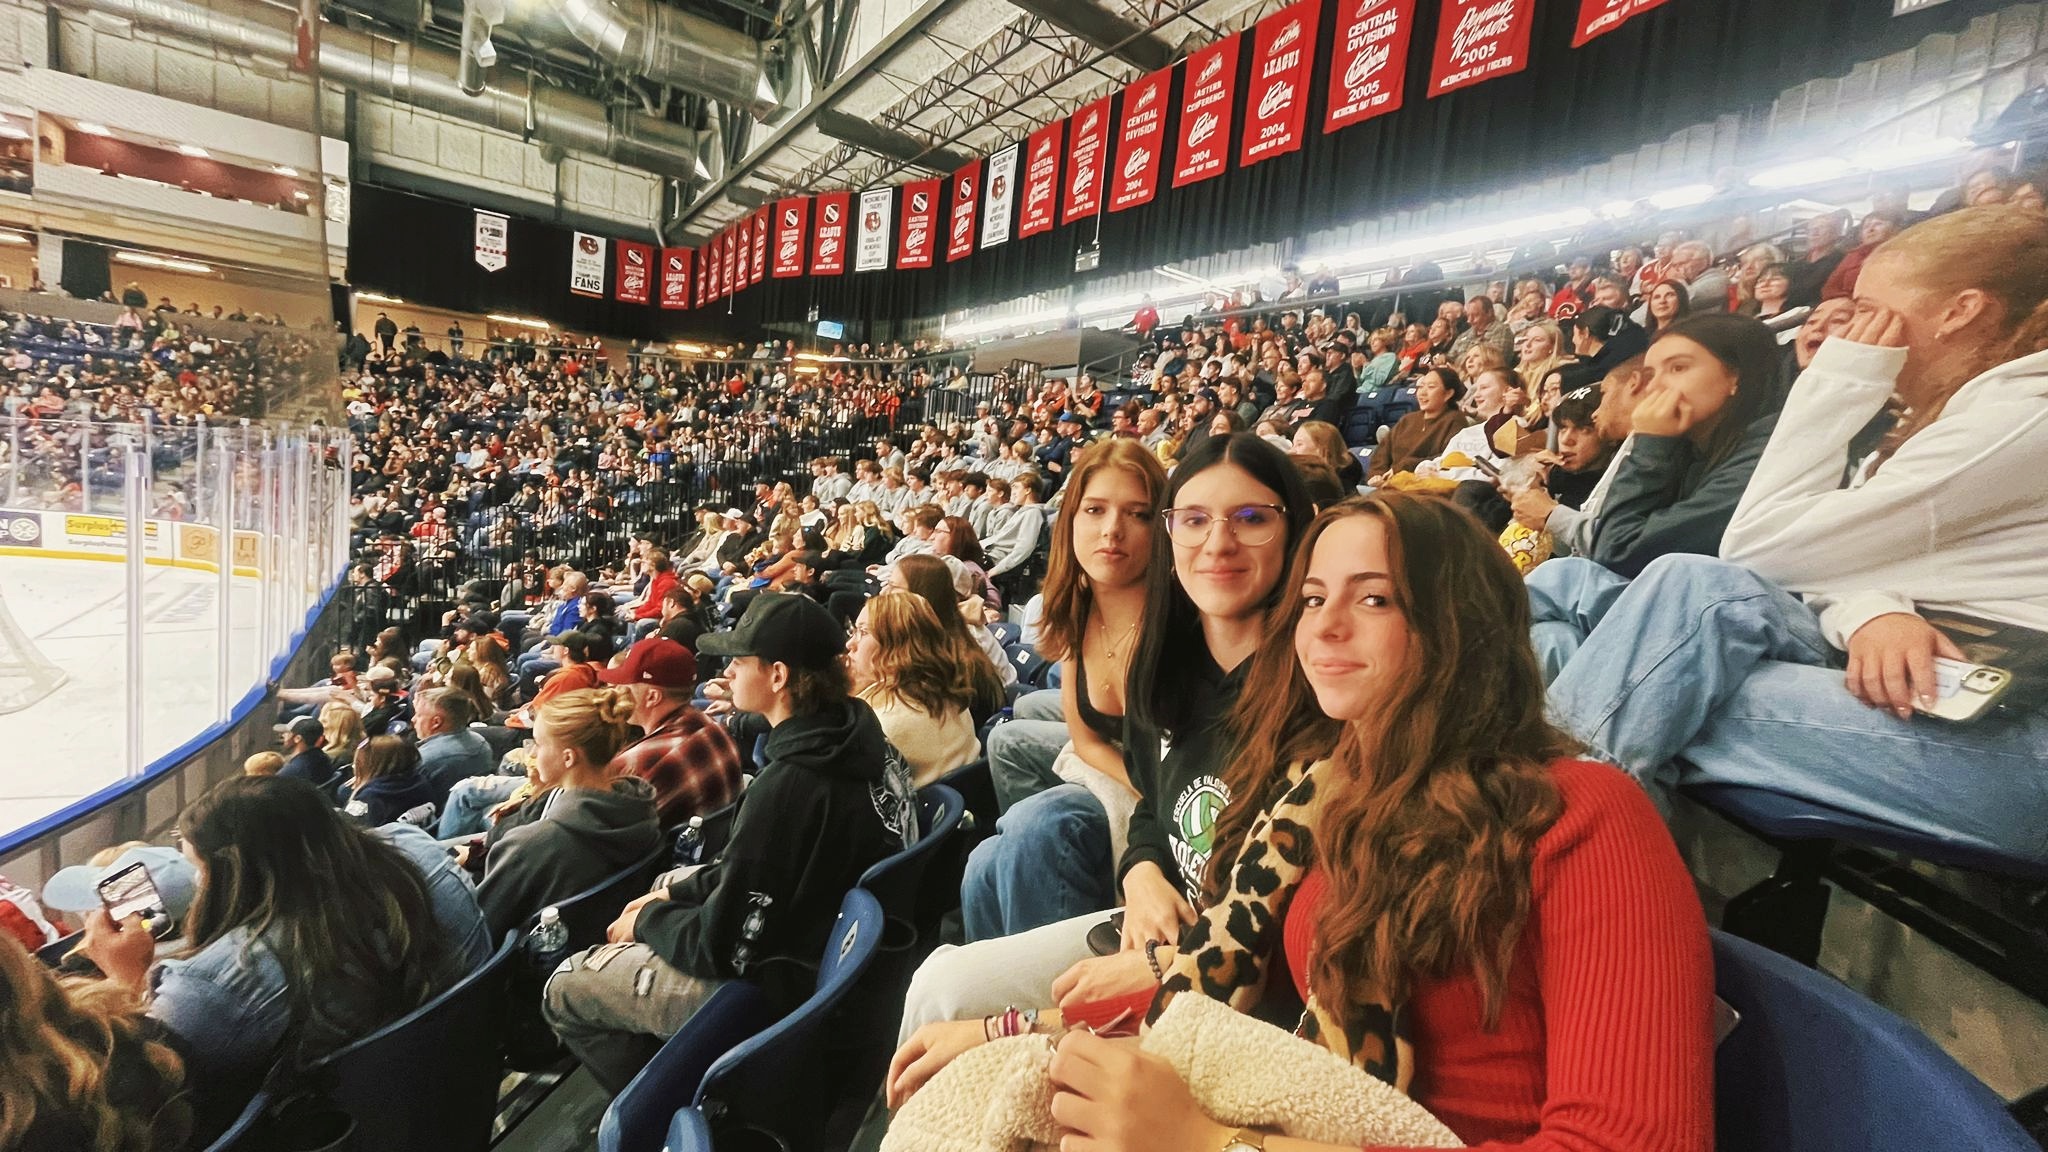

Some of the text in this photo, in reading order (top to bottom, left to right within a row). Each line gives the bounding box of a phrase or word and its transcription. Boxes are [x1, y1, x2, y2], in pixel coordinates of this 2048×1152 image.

[1348, 8, 1398, 39] CENTRAL
[1347, 21, 1397, 52] DIVISION
[1460, 41, 1498, 67] 2005
[1348, 80, 1380, 103] 2005
[1127, 108, 1157, 129] CENTRAL
[1125, 121, 1157, 142] DIVISION
[1260, 122, 1285, 139] 2004
[1189, 149, 1210, 165] 2004
[574, 276, 601, 291] FANS
[67, 520, 111, 532] Surplus
[1173, 785, 1194, 823] ESCUELA
[1193, 776, 1203, 790] DE
